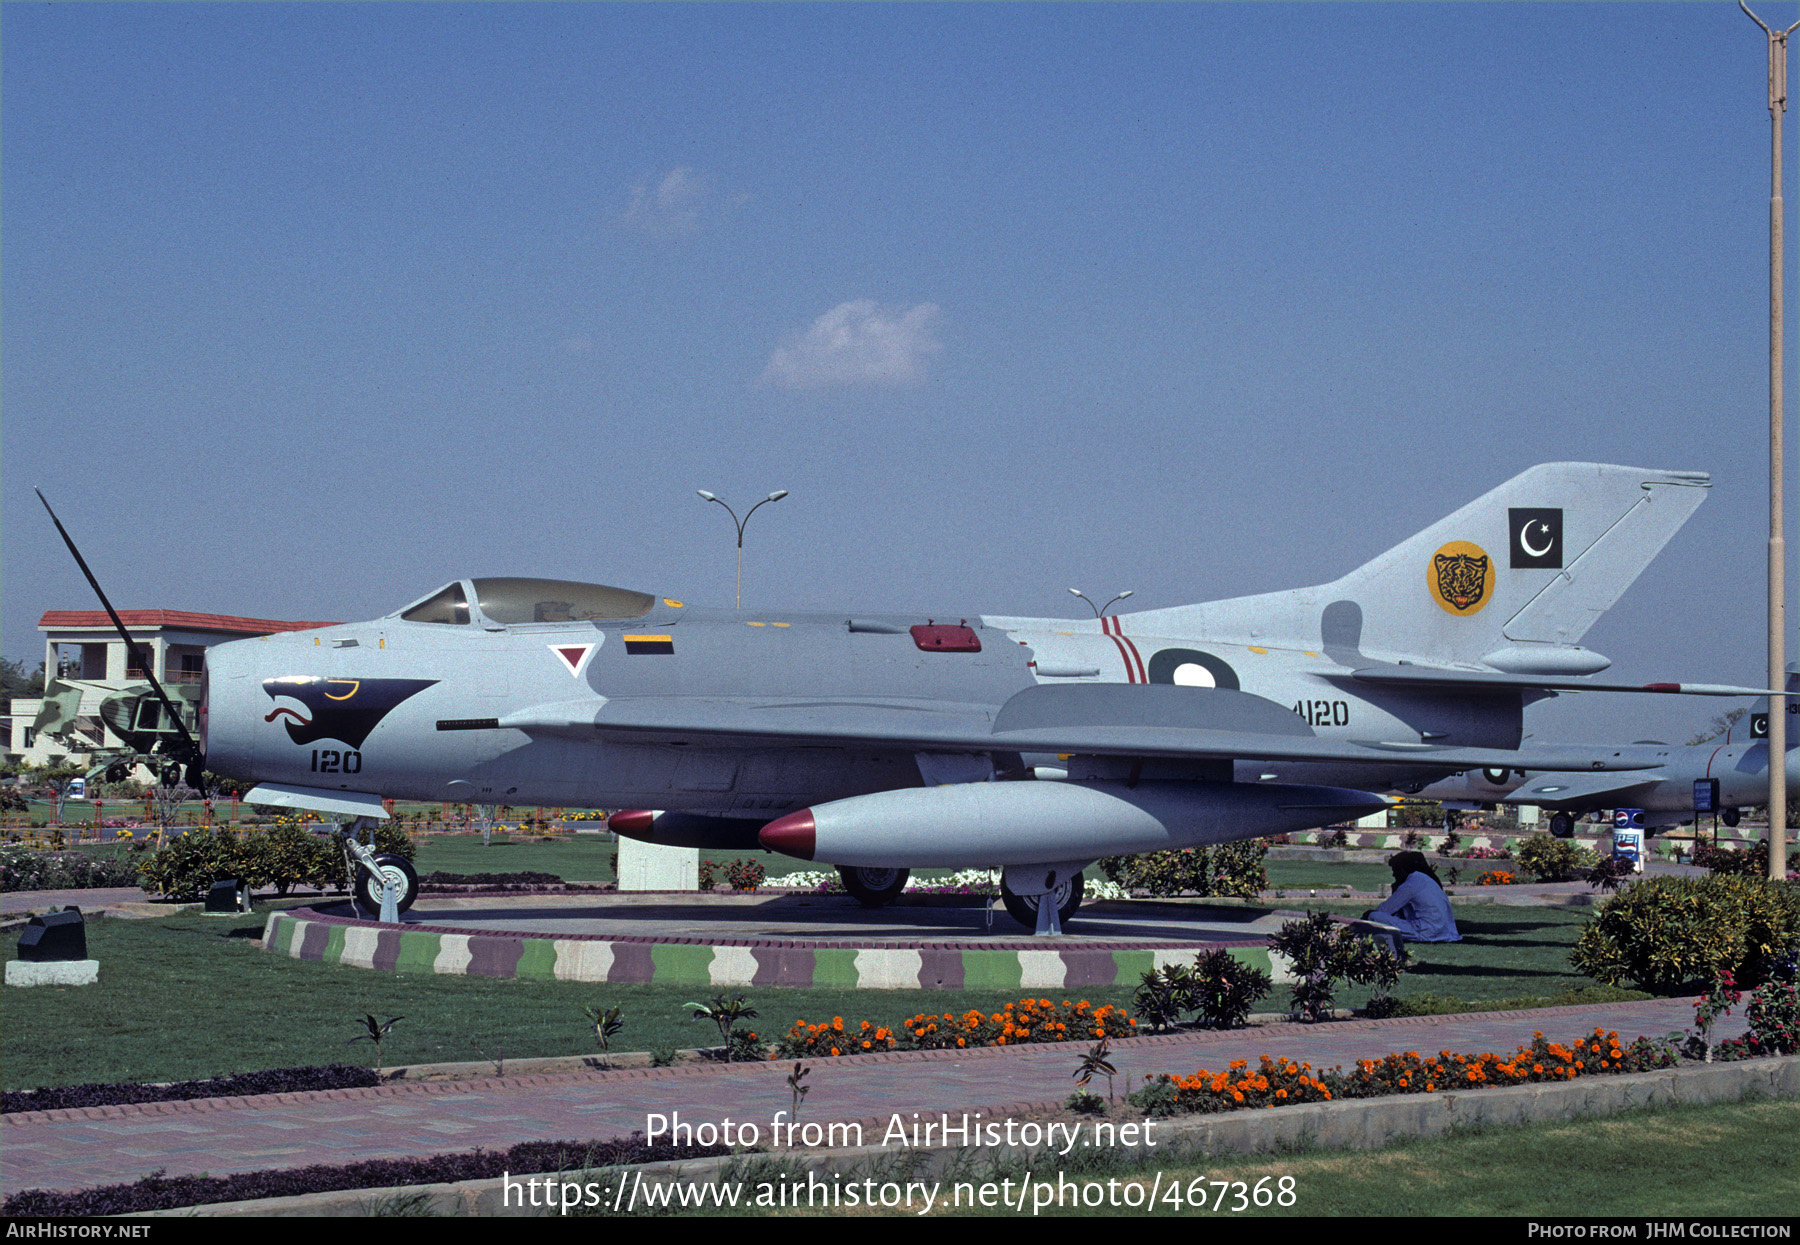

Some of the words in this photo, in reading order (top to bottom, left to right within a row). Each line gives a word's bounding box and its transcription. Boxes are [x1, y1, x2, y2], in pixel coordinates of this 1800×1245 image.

[1292, 700, 1349, 726] 4120
[1785, 704, 1800, 714] -13
[311, 750, 362, 773] 120
